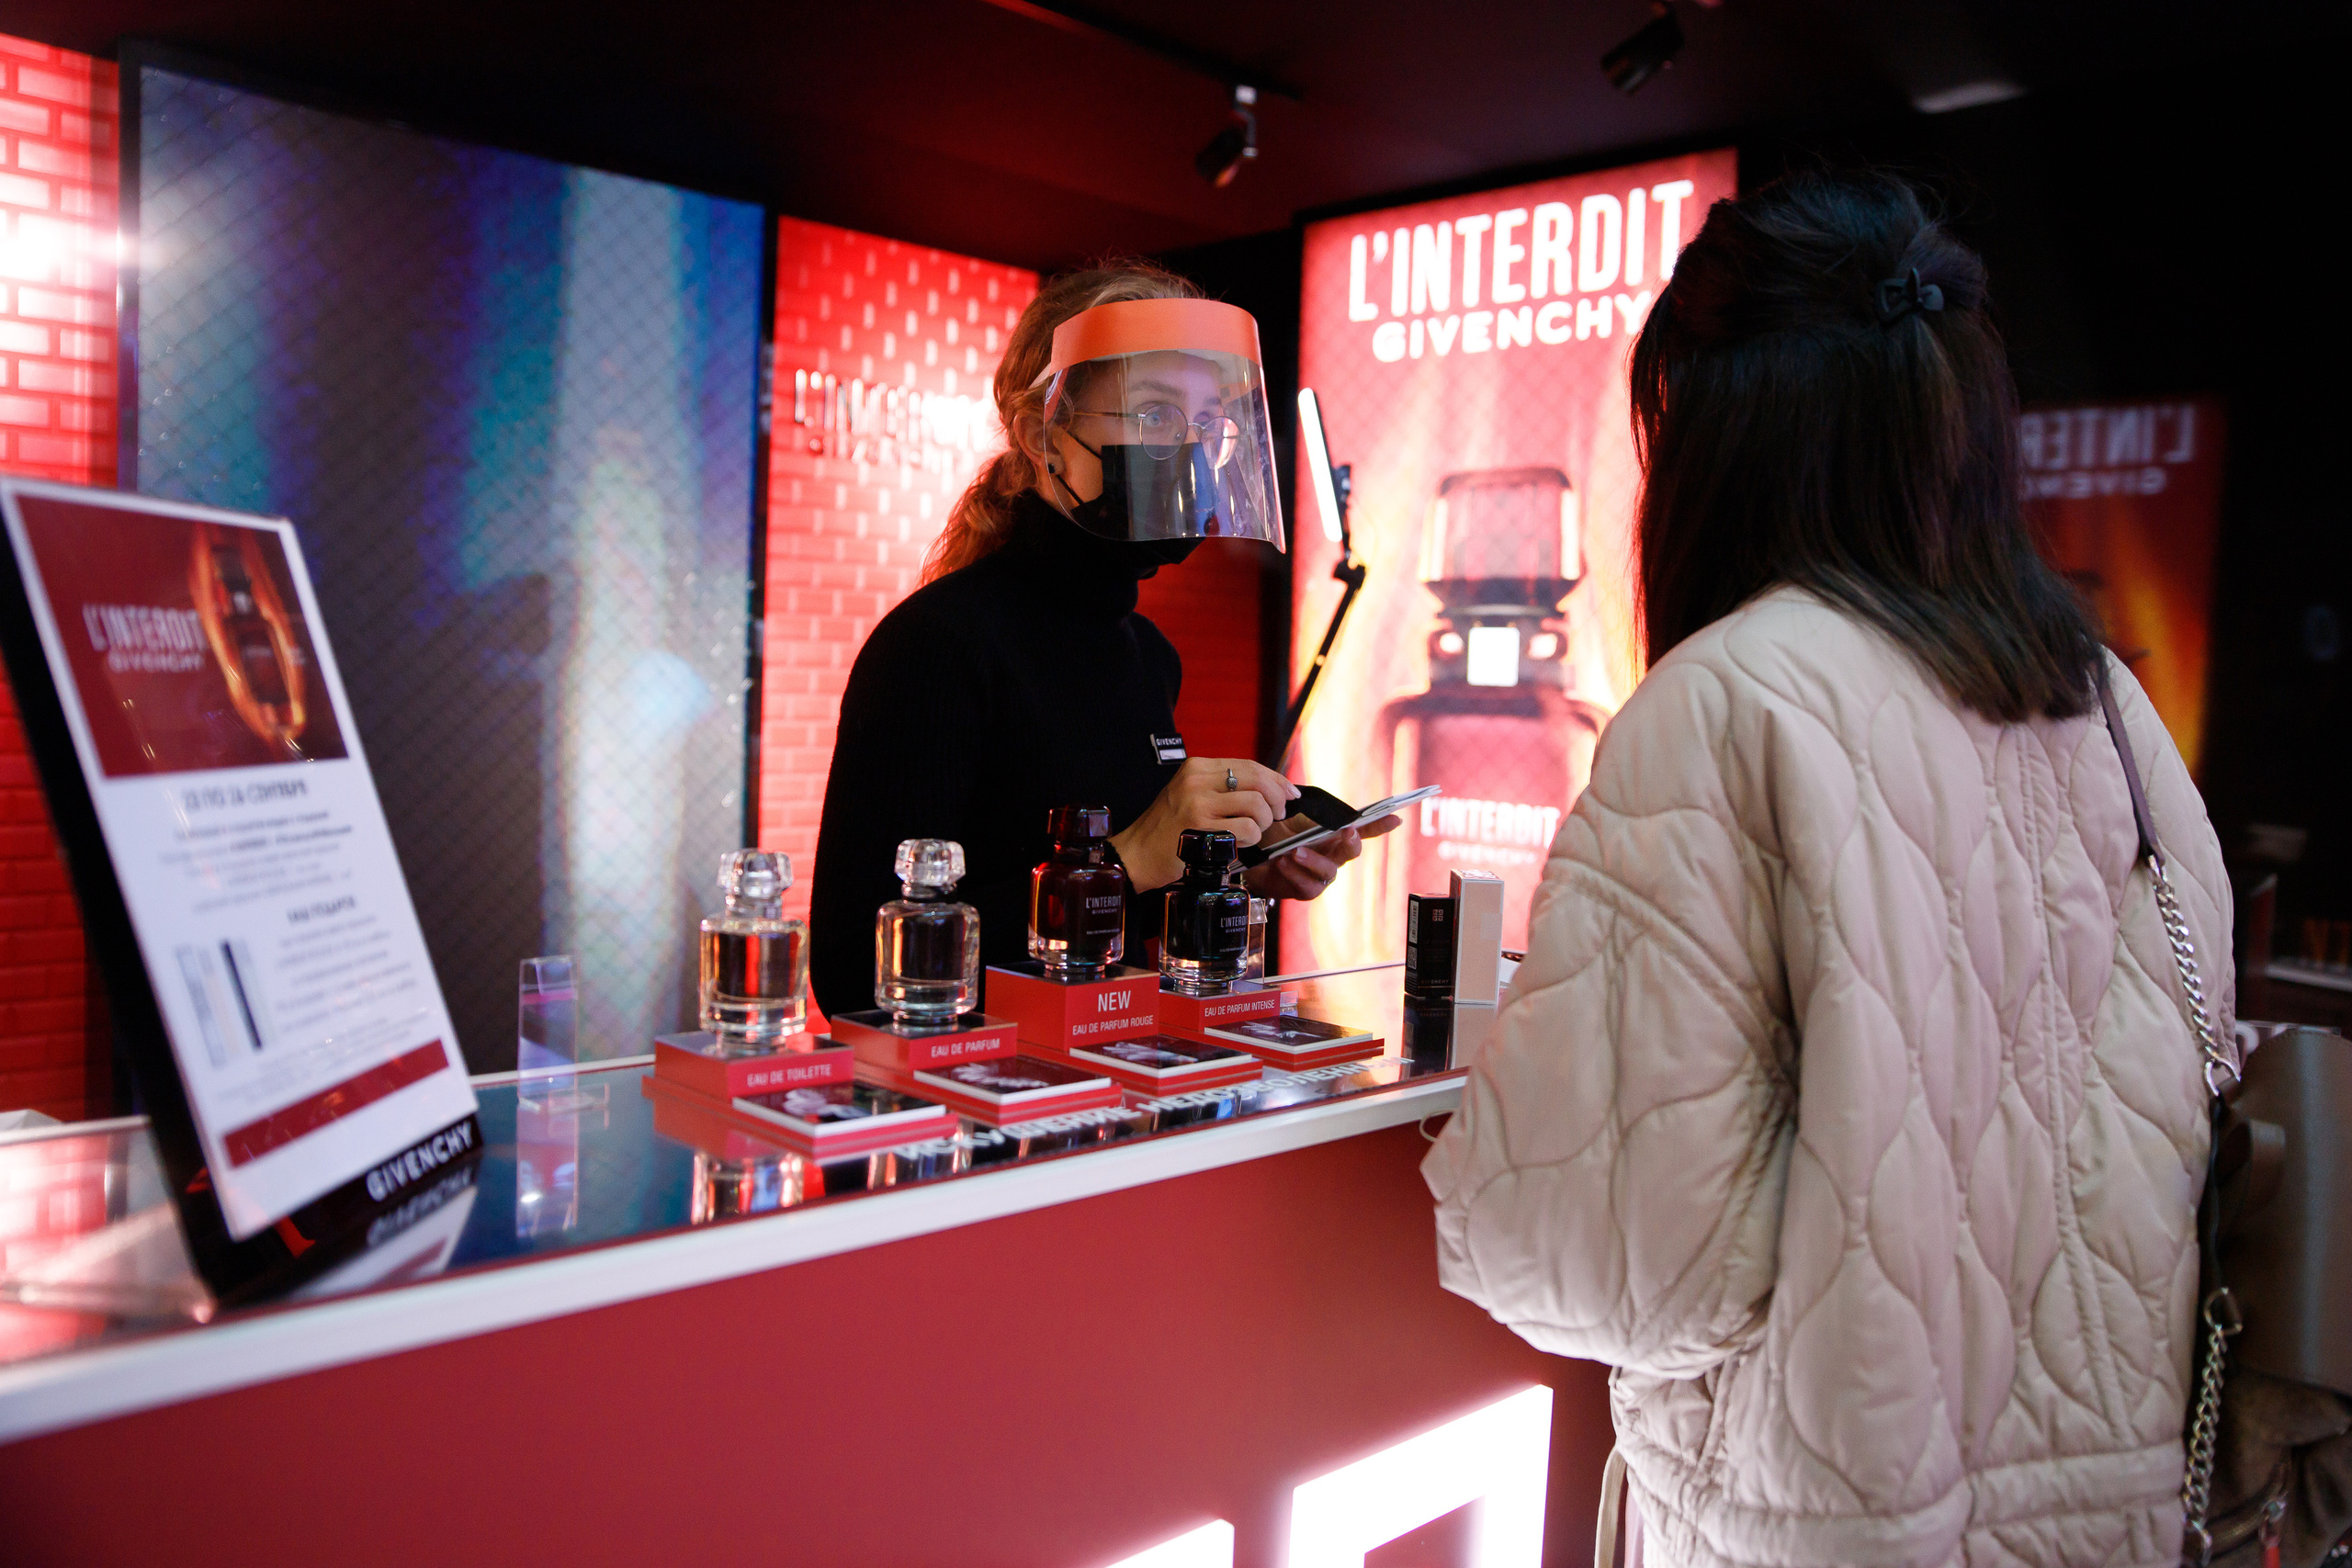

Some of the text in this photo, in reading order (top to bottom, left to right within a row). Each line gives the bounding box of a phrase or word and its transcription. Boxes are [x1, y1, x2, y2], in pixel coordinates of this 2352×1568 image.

[1349, 179, 1695, 322] L'INTERDIT
[1373, 290, 1652, 363] GIVENCHY
[1156, 738, 1182, 746] GIVENCHY
[1420, 795, 1561, 851] L'INTERDIT
[1085, 896, 1121, 908] L'INTERDIT
[1098, 990, 1132, 1011] NEW
[1204, 998, 1275, 1017] EAU DE PARFUM INTENSE
[1072, 1014, 1154, 1036] EAU DE PARFUM ROUGE
[931, 1037, 1001, 1058] EAU DE PARFUM
[746, 1063, 831, 1088] EAU DE TOILETTE
[366, 1121, 473, 1202] GIVENCHY
